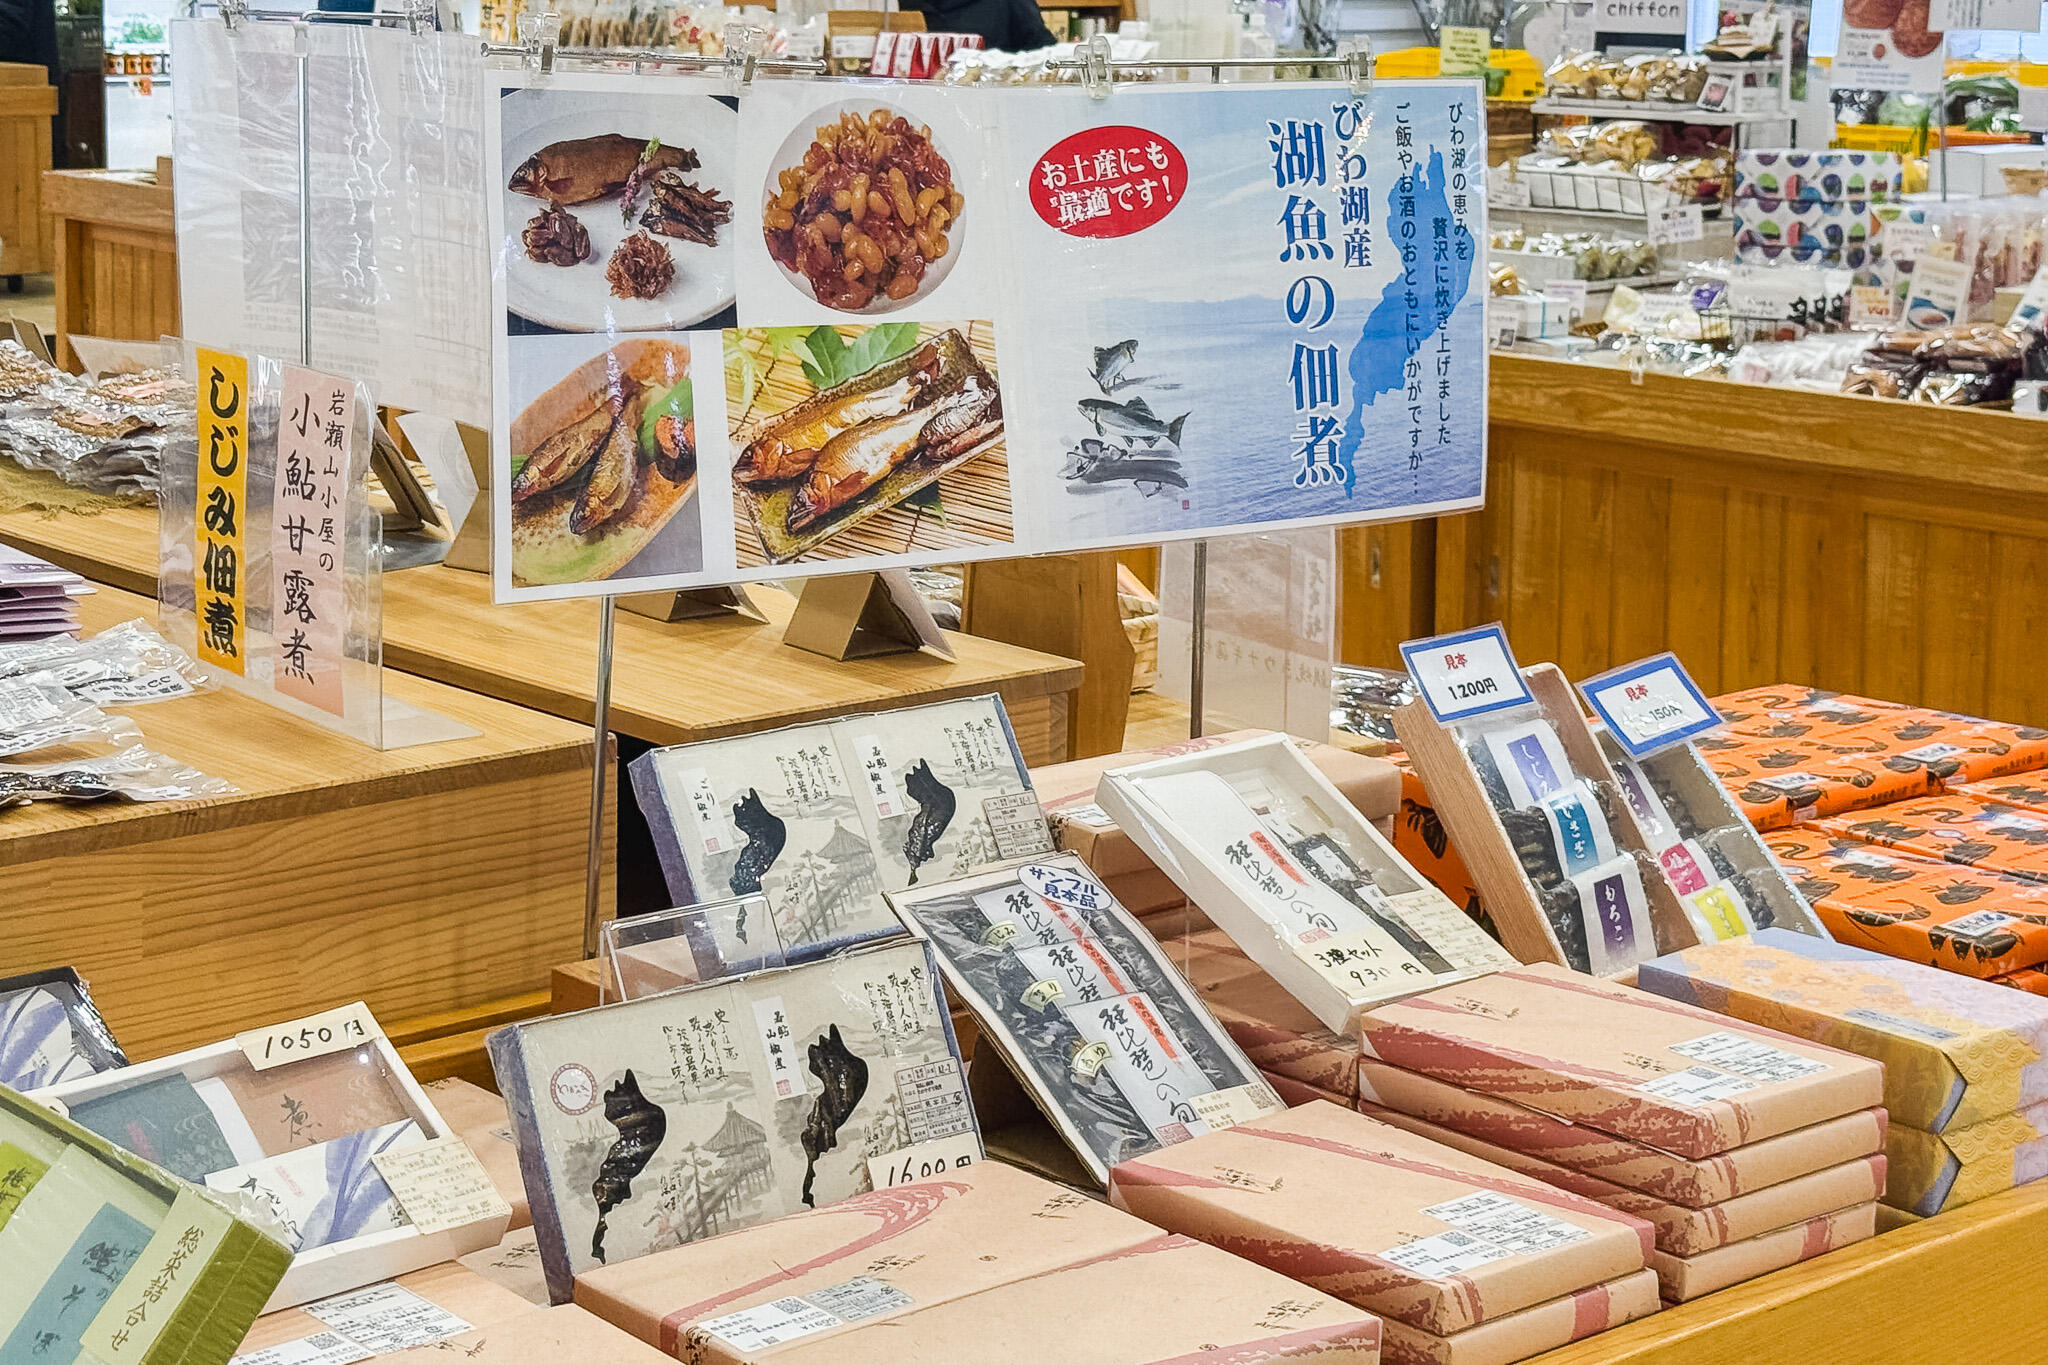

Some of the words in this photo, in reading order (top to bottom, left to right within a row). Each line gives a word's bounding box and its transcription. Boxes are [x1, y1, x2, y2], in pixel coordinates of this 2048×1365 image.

[1606, 1, 1681, 17] chiffon
[1040, 139, 1170, 190] お土産にも
[1331, 100, 1374, 270] びわ湖産
[1448, 102, 1469, 261] びわ湖の恵みを
[1267, 119, 1347, 488] 湖魚の佃煮
[1431, 216, 1453, 446] 贅沢に炊き上げました
[202, 365, 240, 658] しじみ佃煮
[281, 391, 320, 685] 小鮎甘露煮
[317, 388, 345, 573] 岩瀬山小屋の
[1444, 652, 1468, 670] 見本
[1624, 683, 1649, 702] 見本
[1043, 882, 1099, 911] 見本品
[1604, 883, 1624, 942] もろこ
[264, 1018, 366, 1060] 1050円
[110, 1224, 205, 1352] 総菜詰合せ
